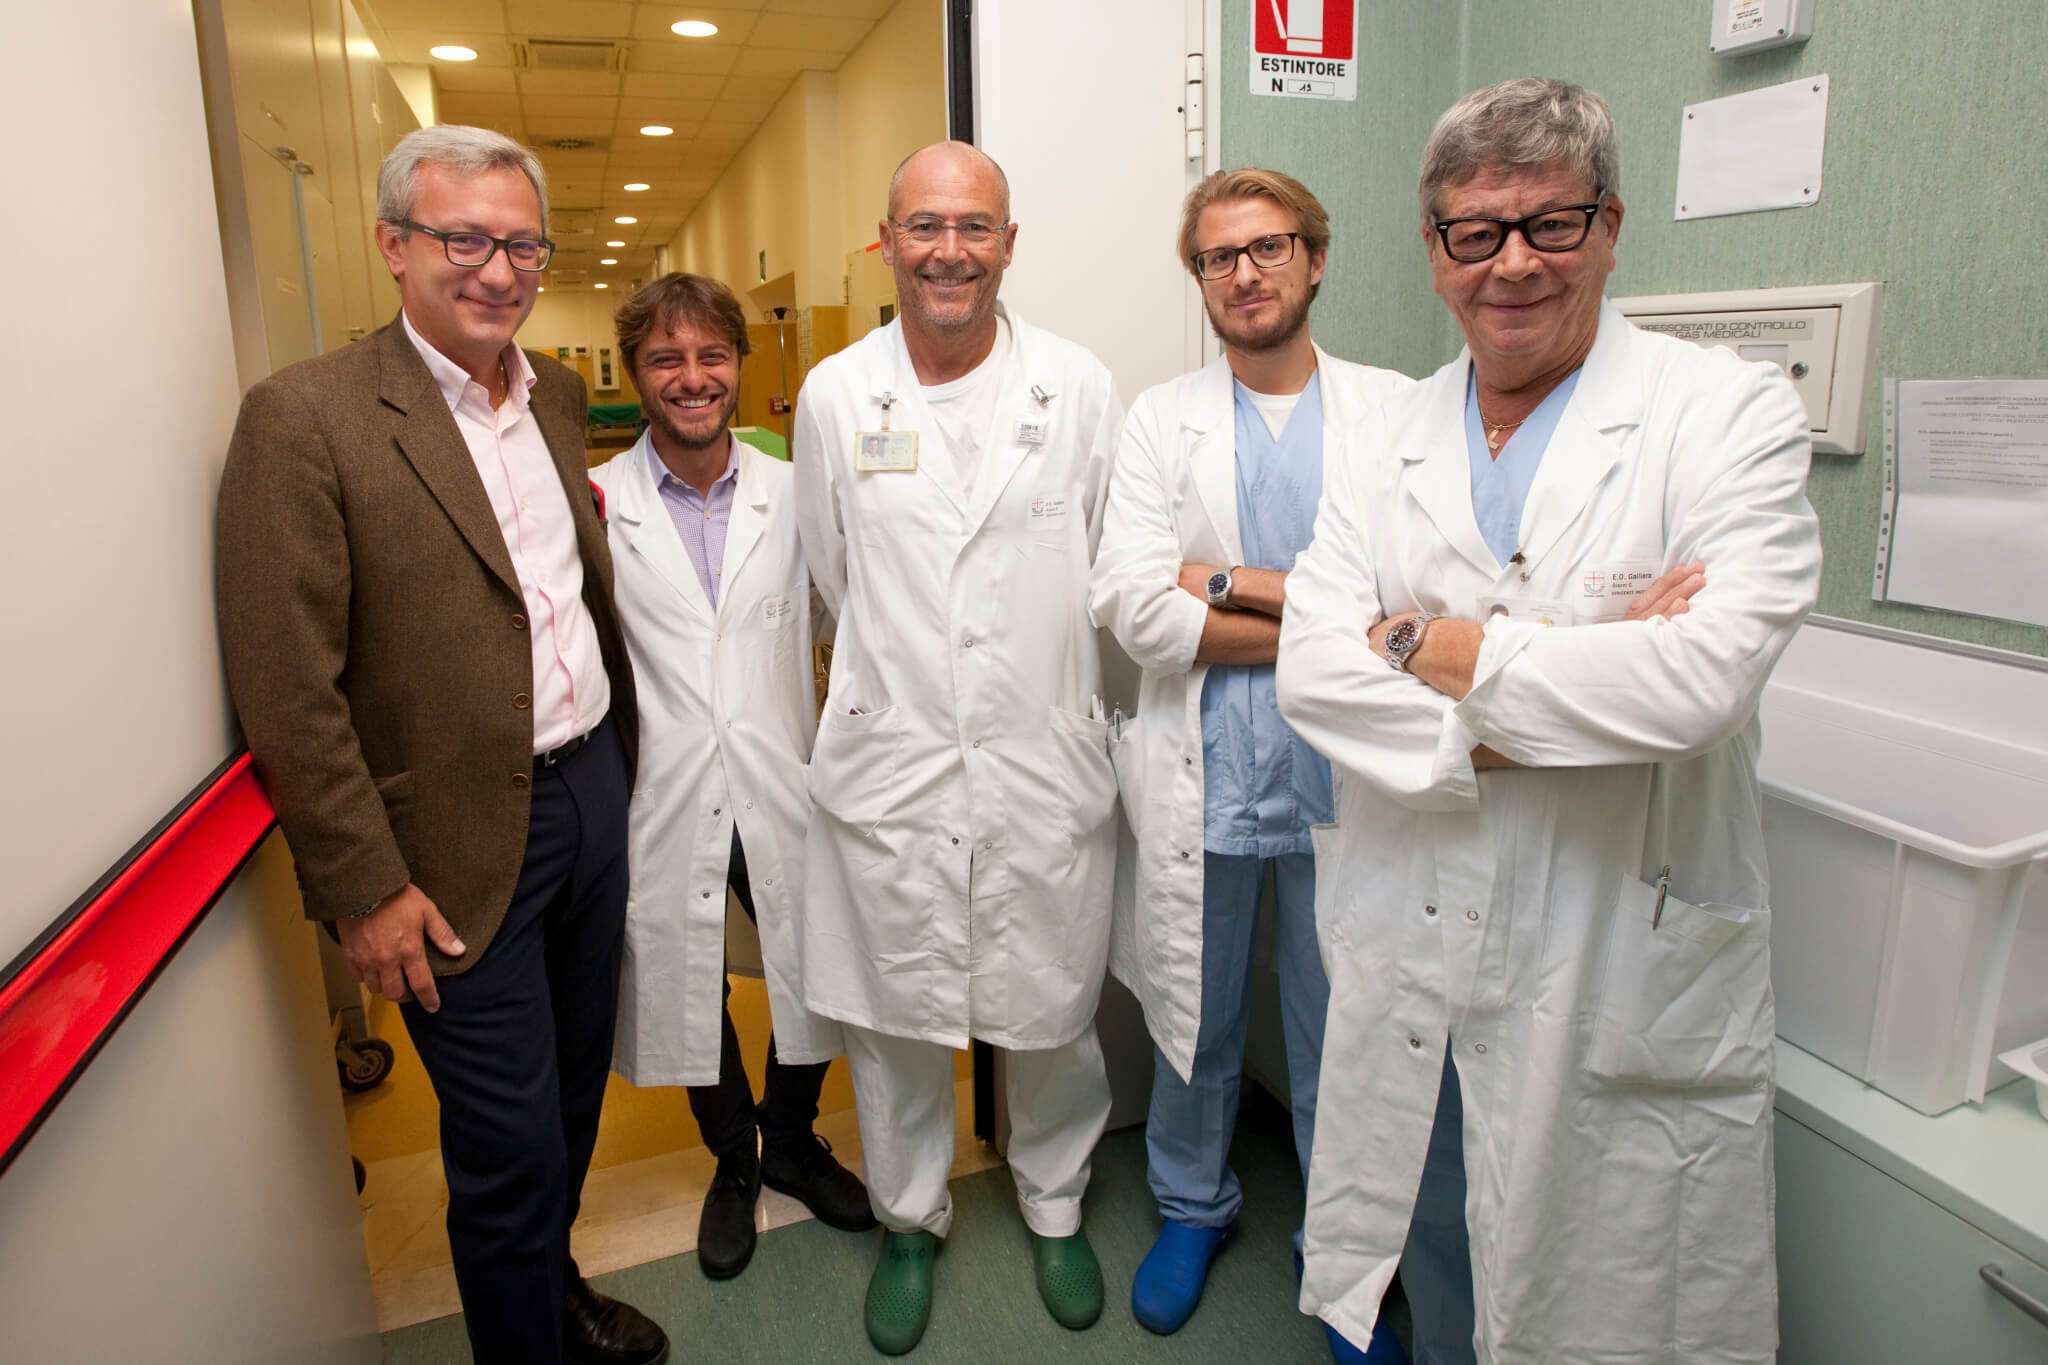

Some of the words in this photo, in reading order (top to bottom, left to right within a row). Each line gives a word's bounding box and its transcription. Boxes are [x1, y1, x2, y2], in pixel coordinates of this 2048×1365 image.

[1261, 57, 1346, 77] ESTINTORE
[1272, 78, 1283, 92] N
[1715, 322, 1727, 331] DI
[1729, 320, 1806, 330] CONTROLLO
[1675, 331, 1699, 339] GAS
[1703, 330, 1760, 339] MEDICALI
